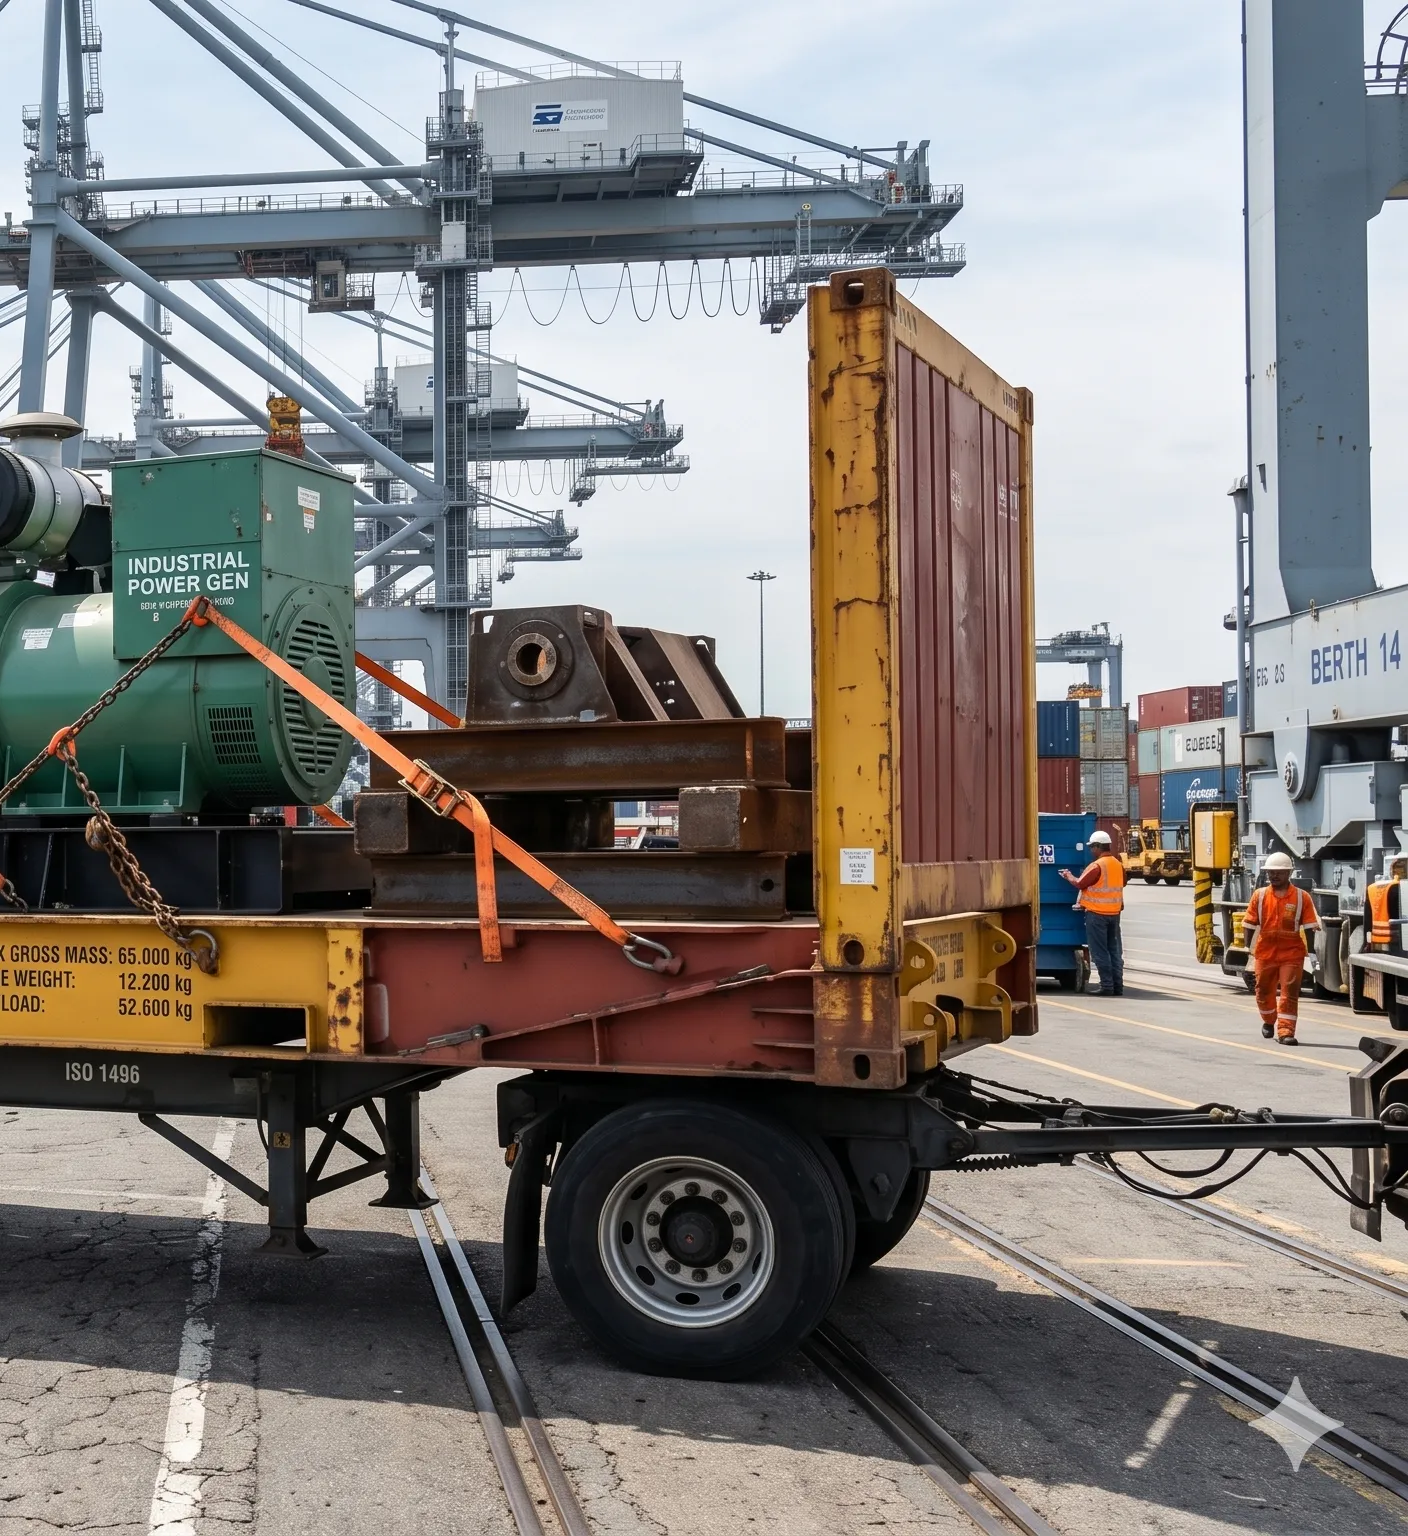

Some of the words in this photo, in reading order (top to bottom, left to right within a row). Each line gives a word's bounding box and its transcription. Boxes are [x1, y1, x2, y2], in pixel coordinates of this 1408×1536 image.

[128, 551, 250, 575] INDUSTRIAL
[128, 575, 201, 596] POWER
[206, 572, 249, 591] GEN
[1311, 637, 1368, 685] BERTH
[1379, 629, 1401, 672] 14
[10, 945, 60, 964] GROSS
[65, 946, 113, 965] MASS:
[118, 947, 170, 966] 65.000
[175, 951, 192, 970] kg
[14, 969, 76, 989] WEIGHT:
[118, 973, 170, 992] 12.200
[175, 974, 192, 996] kg
[118, 998, 170, 1017] 52.600
[175, 1000, 192, 1022] kg
[65, 1062, 93, 1082] ISO
[99, 1064, 140, 1084] 1496
